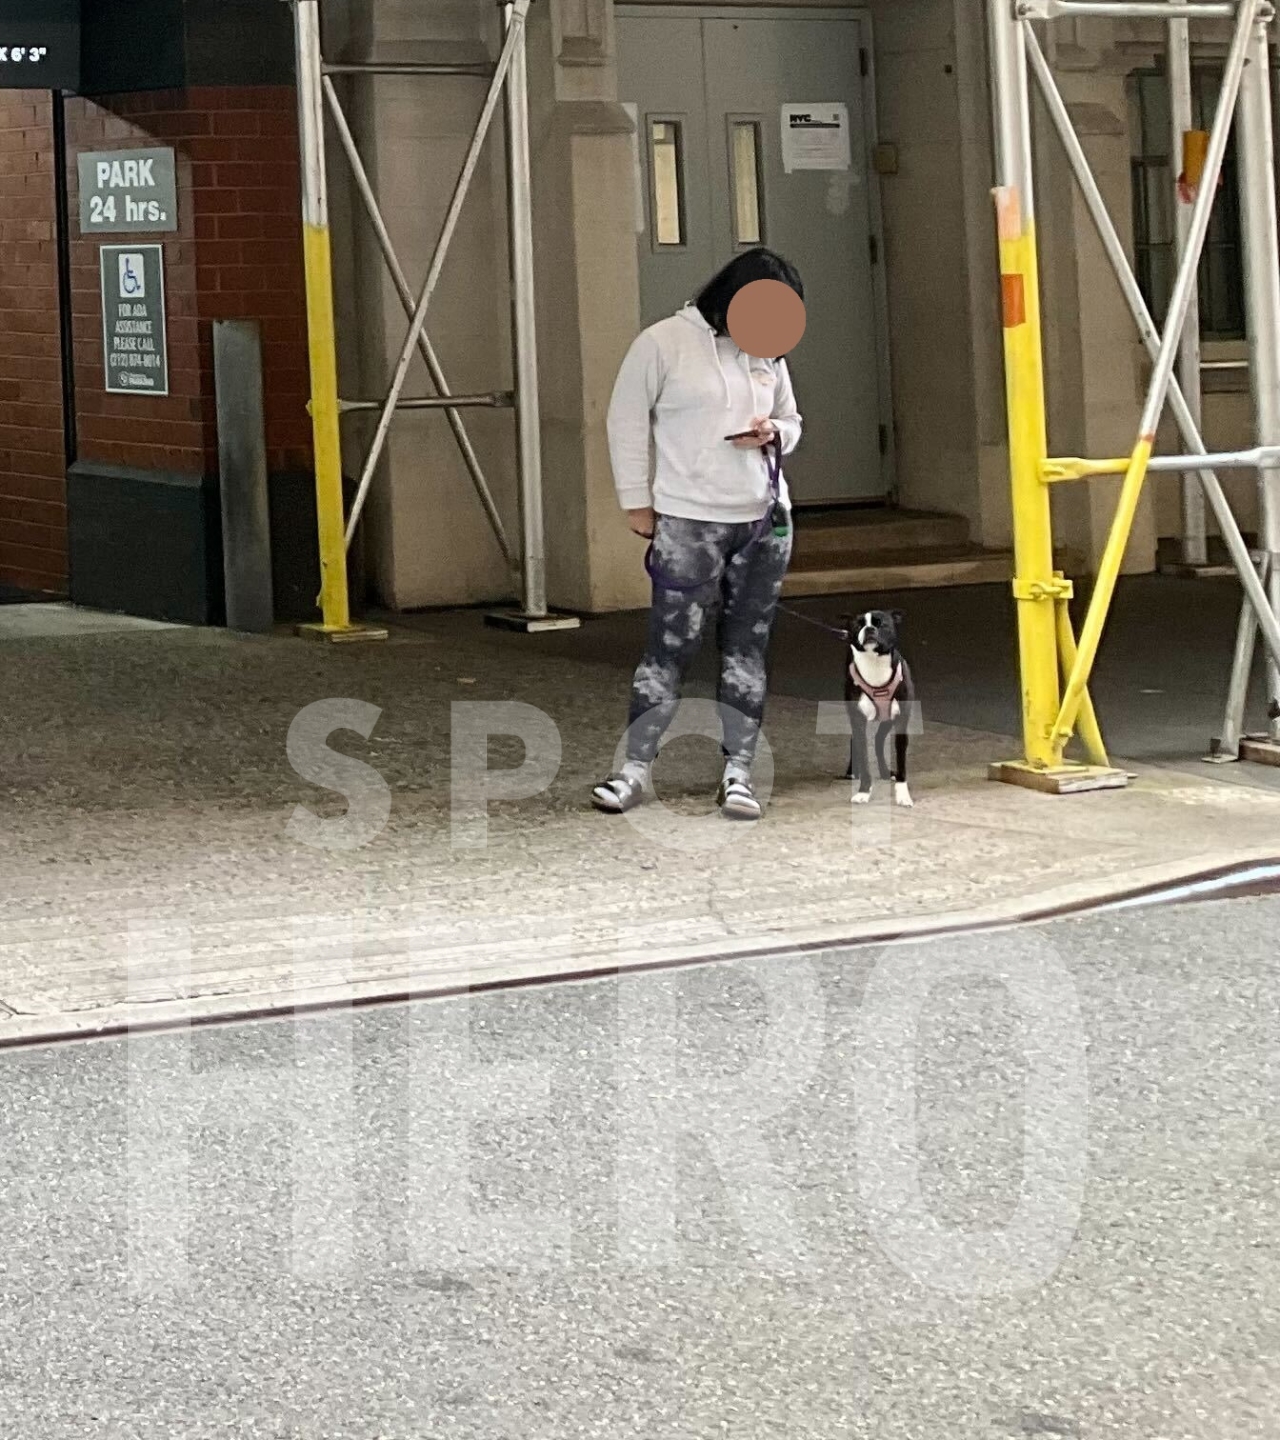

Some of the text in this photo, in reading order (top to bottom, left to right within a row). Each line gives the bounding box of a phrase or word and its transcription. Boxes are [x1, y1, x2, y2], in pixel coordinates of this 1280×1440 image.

[96, 159, 155, 189] PARK
[90, 195, 167, 223] 24 hrs.
[118, 303, 131, 318] FOR
[115, 320, 153, 334] ASSISTANCE
[113, 336, 155, 351] PLEASE CALL
